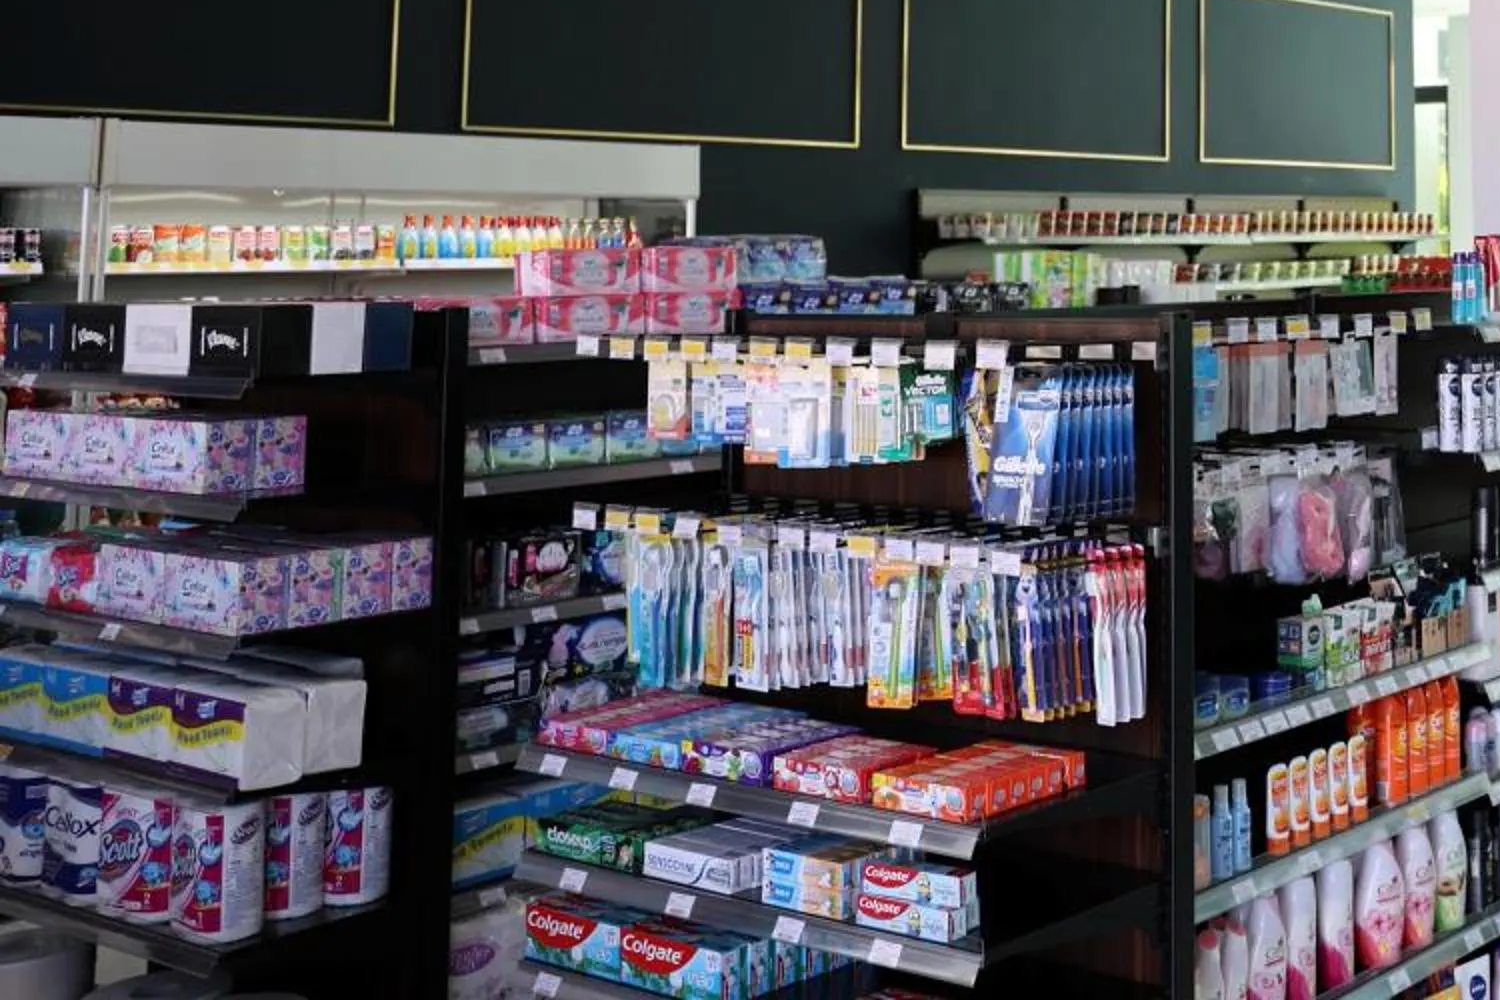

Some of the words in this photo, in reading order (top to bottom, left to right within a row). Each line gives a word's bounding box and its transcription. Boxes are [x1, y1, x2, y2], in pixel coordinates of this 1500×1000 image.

[993, 456, 1046, 475] Gillette
[100, 833, 143, 866] Scott
[865, 864, 910, 884] Colgate
[858, 896, 901, 915] Colgate
[526, 910, 585, 940] Colgate
[622, 933, 683, 965] Colgate
